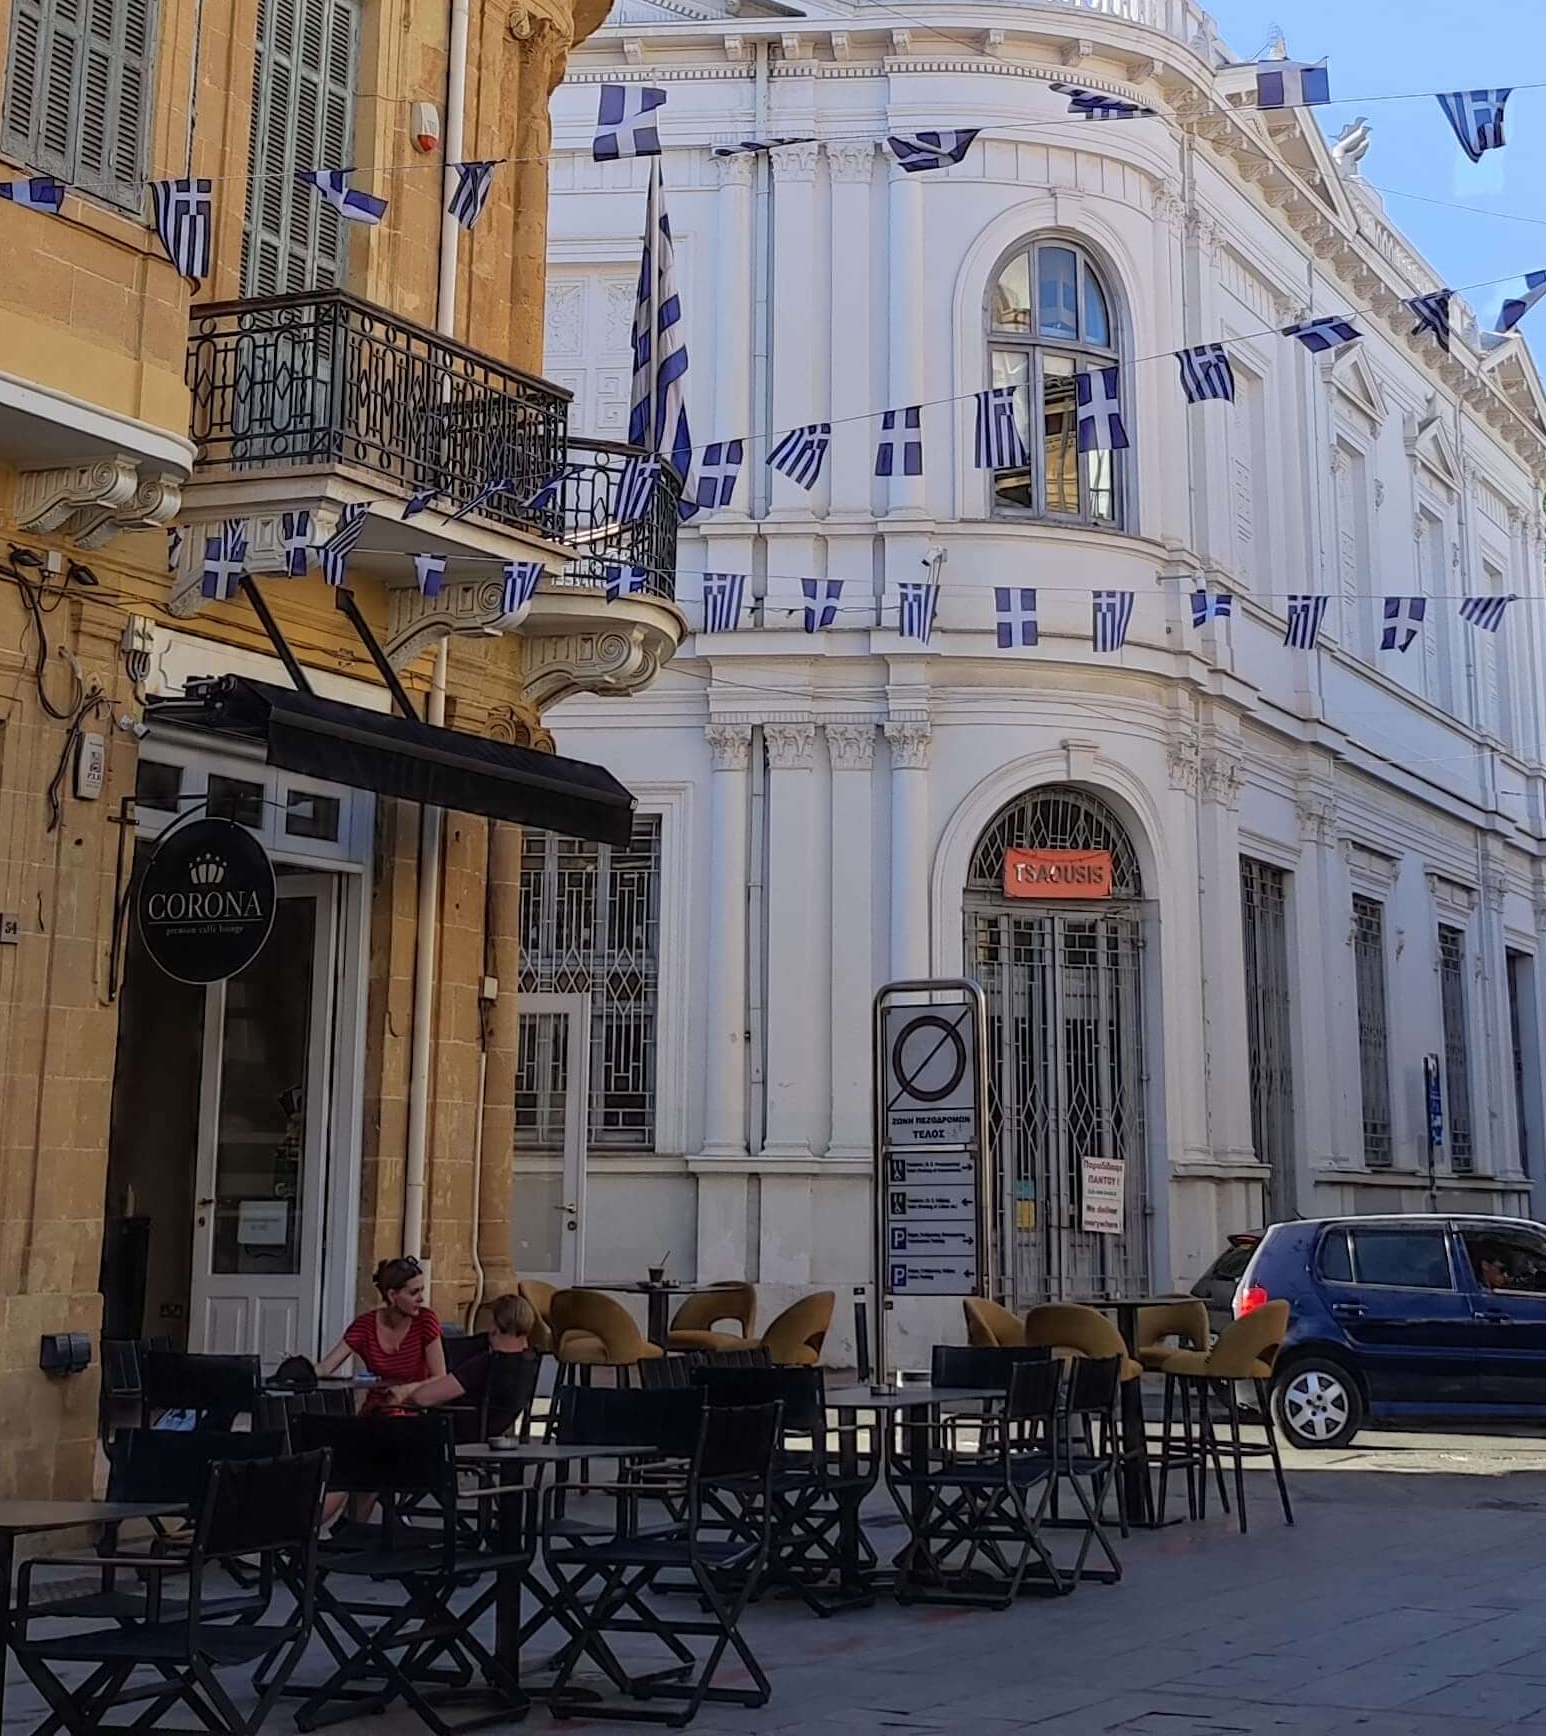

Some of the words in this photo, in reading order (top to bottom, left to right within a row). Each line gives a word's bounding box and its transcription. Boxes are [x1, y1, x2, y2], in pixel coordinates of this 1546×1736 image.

[1015, 864, 1103, 884] TSAOUSIS
[148, 891, 262, 920] CORONA
[912, 1129, 946, 1139] ΤΕΛΟΣ
